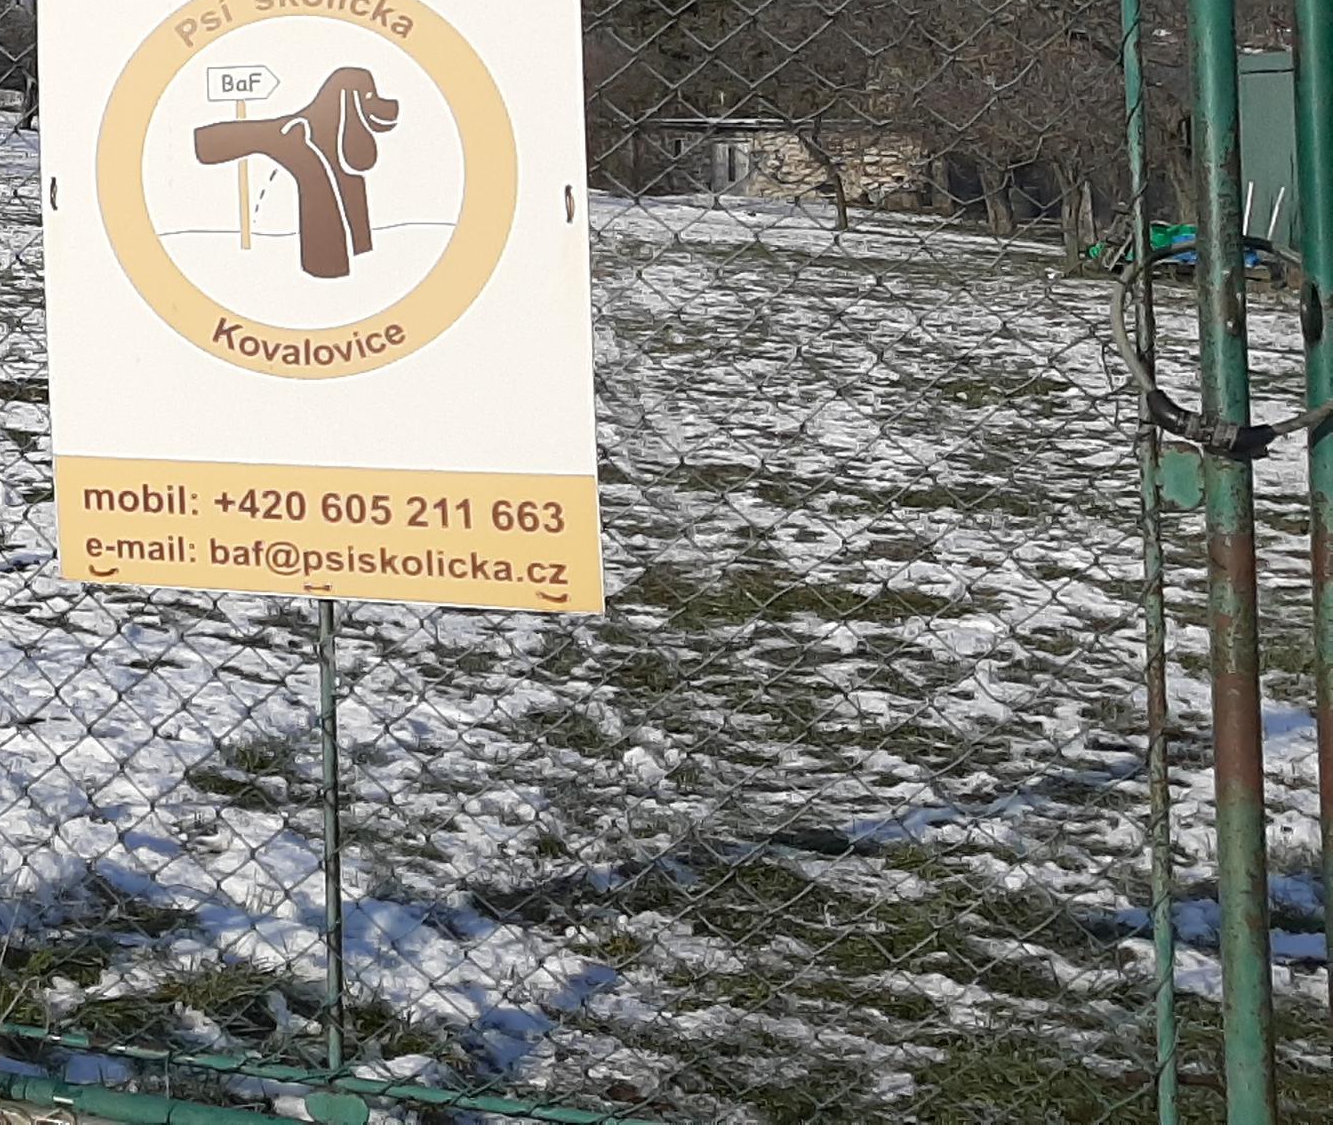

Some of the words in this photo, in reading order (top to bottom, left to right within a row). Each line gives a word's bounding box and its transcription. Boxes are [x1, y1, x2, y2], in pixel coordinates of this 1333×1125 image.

[221, 73, 262, 92] BaF
[211, 317, 406, 367] Kovalovice
[83, 483, 200, 516] mobil:
[214, 488, 306, 520] +420
[320, 492, 393, 526] 605
[407, 495, 474, 530] 211
[491, 500, 566, 534] 663
[85, 533, 197, 564] e-mail:
[209, 538, 569, 585] baf@psiskolicka.cz
